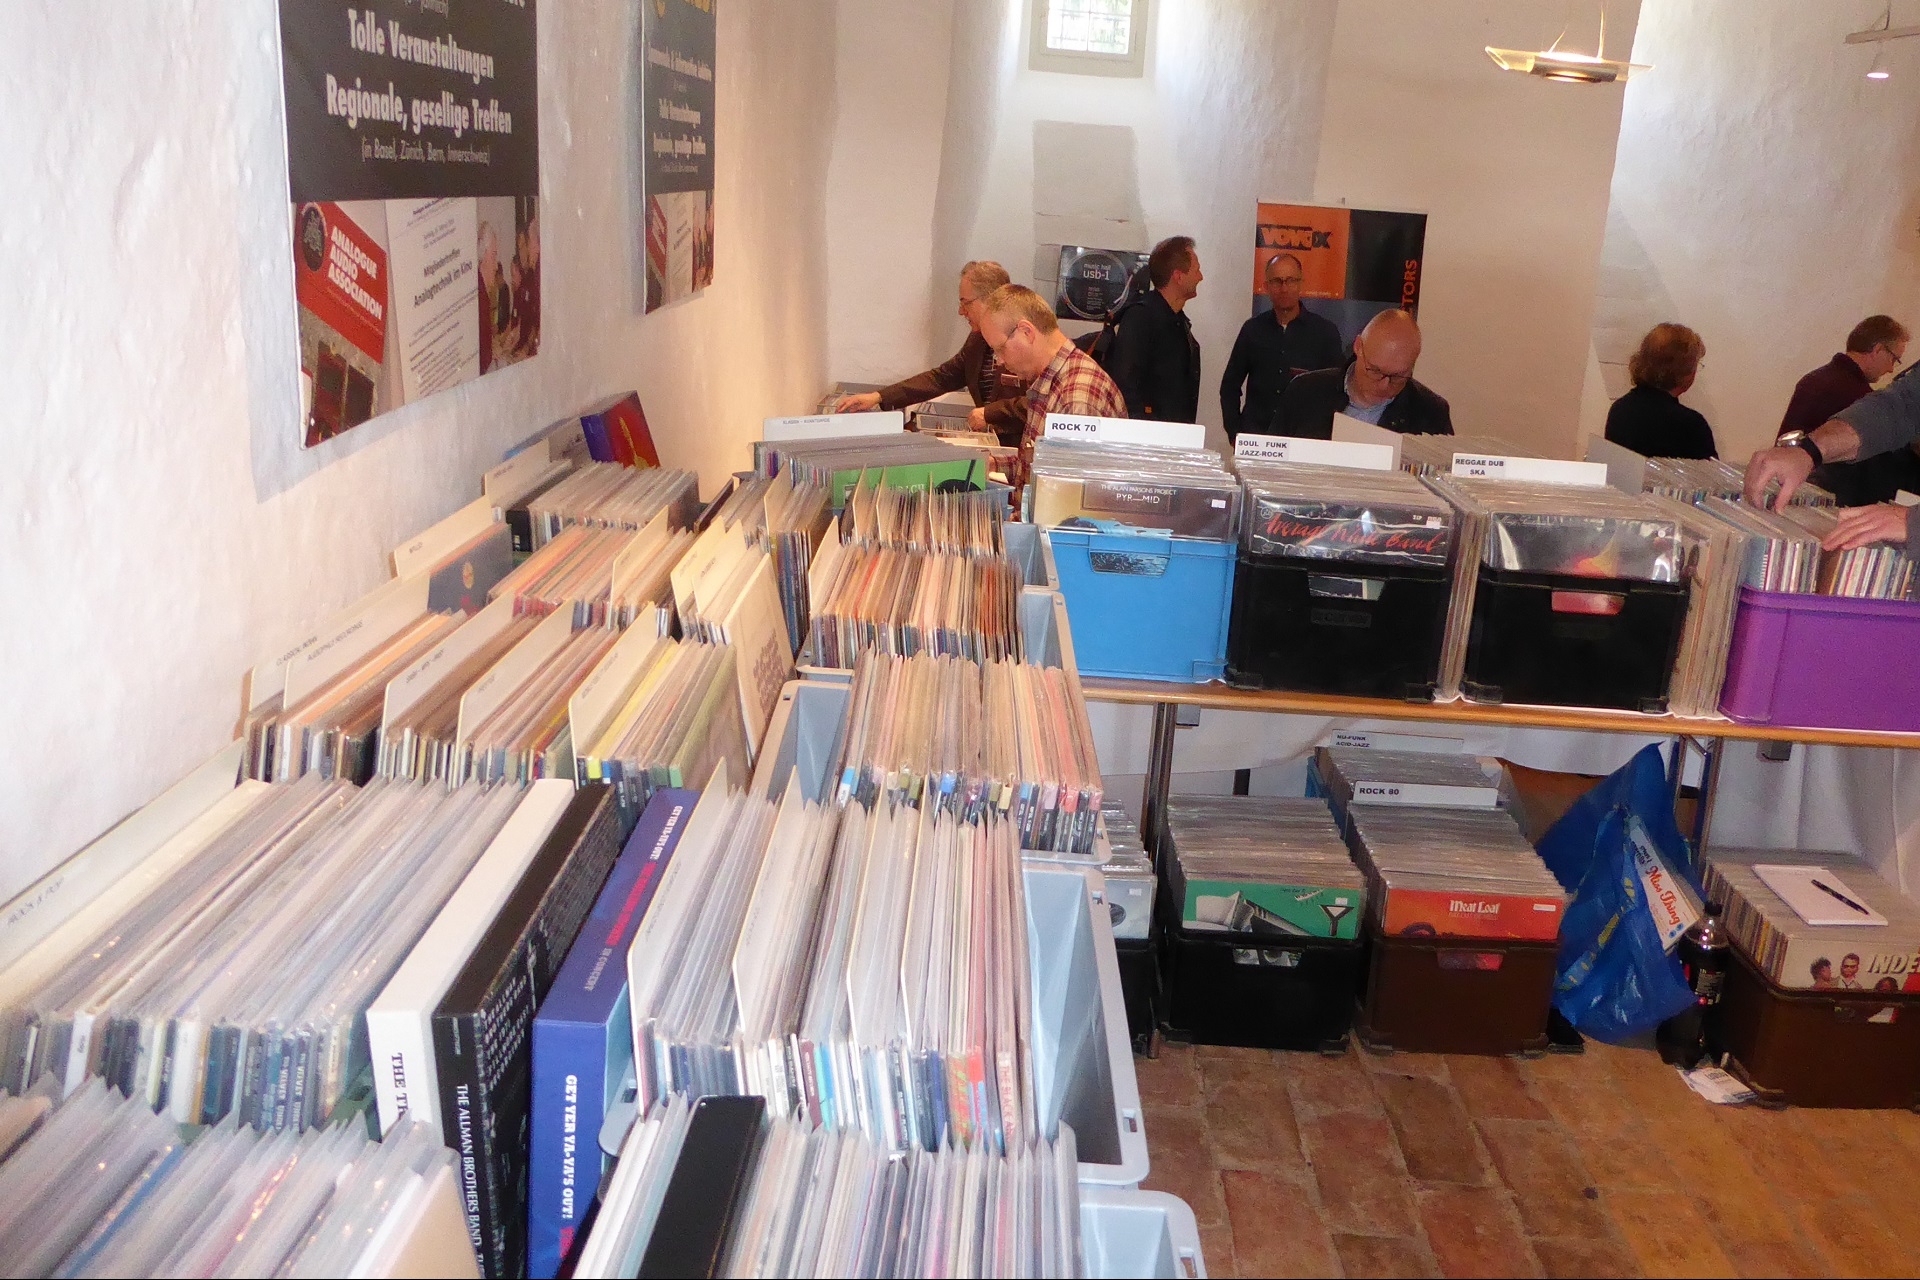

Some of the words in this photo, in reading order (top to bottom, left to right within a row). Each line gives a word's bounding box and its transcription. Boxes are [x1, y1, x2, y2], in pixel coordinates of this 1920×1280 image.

[347, 8, 386, 55] Tolle
[388, 19, 495, 85] Veranstaltungen
[326, 73, 408, 131] Regionale,
[411, 90, 470, 138] gesellige
[471, 98, 513, 135] Treffen
[330, 244, 359, 281] AUDIO
[331, 226, 378, 280] ANALOGUE
[1082, 269, 1110, 281] usb-1
[327, 262, 383, 320] ASSOCIATION
[1051, 422, 1081, 432] ROCK
[1084, 424, 1097, 432] 70
[1238, 439, 1259, 448] SOUL
[1265, 441, 1288, 449] FUNK
[1239, 449, 1284, 458] JAZZ-ROCK
[1455, 458, 1487, 466] REGGAE
[1100, 484, 1113, 492] THE
[1112, 485, 1130, 493] ALAN
[1129, 486, 1154, 495] PARSONS
[1153, 488, 1177, 496] PROJECT
[1385, 529, 1446, 554] Band
[1359, 787, 1385, 795] ROCK
[1388, 788, 1400, 796] 80
[1449, 899, 1476, 913] Meat
[1477, 901, 1501, 915] Loaf
[391, 1052, 407, 1088] THE
[457, 1083, 470, 1105] THE
[565, 1074, 578, 1103] GET
[459, 1105, 474, 1157] ALLMAN
[564, 1105, 577, 1133] YER
[463, 1157, 480, 1212] BROTHERS
[562, 1187, 574, 1219] OUT!
